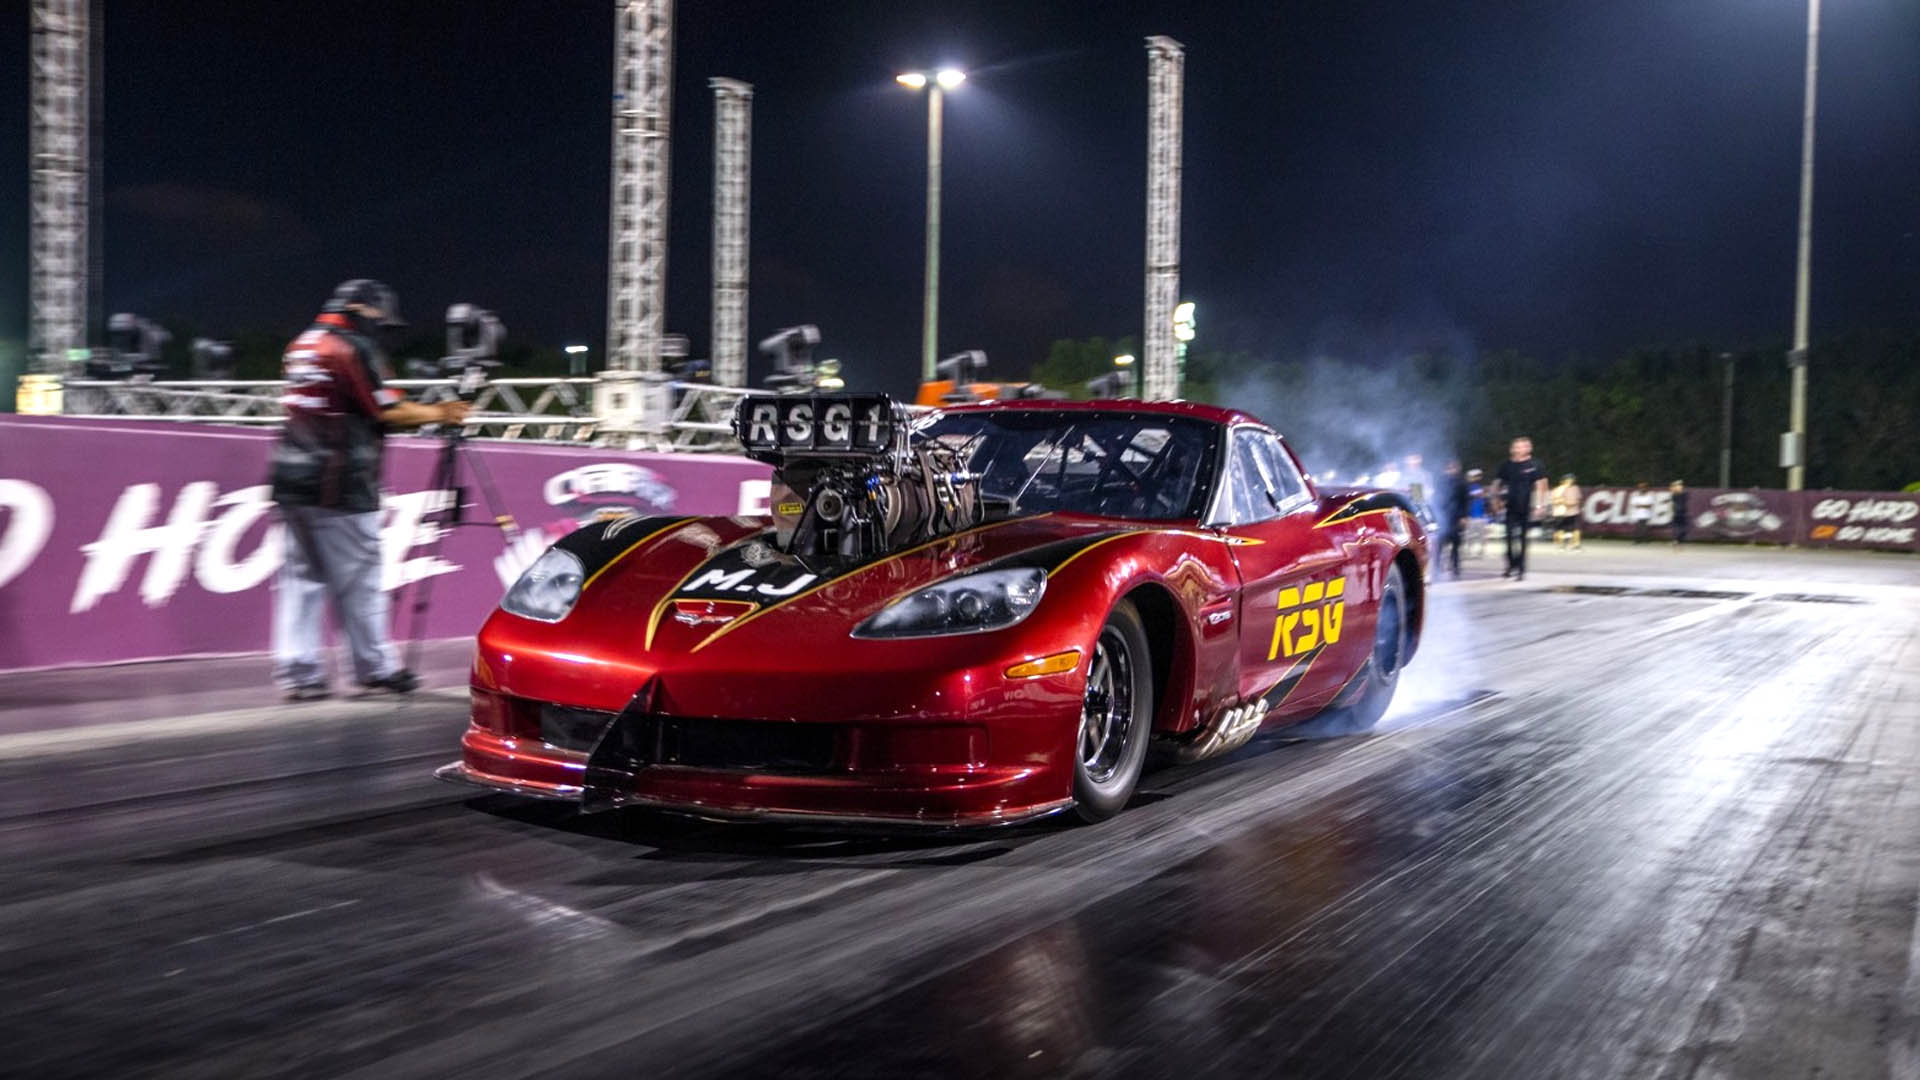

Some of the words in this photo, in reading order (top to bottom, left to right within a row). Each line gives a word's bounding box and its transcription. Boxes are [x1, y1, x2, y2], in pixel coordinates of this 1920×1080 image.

[70, 481, 463, 613] HOE
[1583, 490, 1675, 526] CLB
[1267, 576, 1346, 661] RSG
